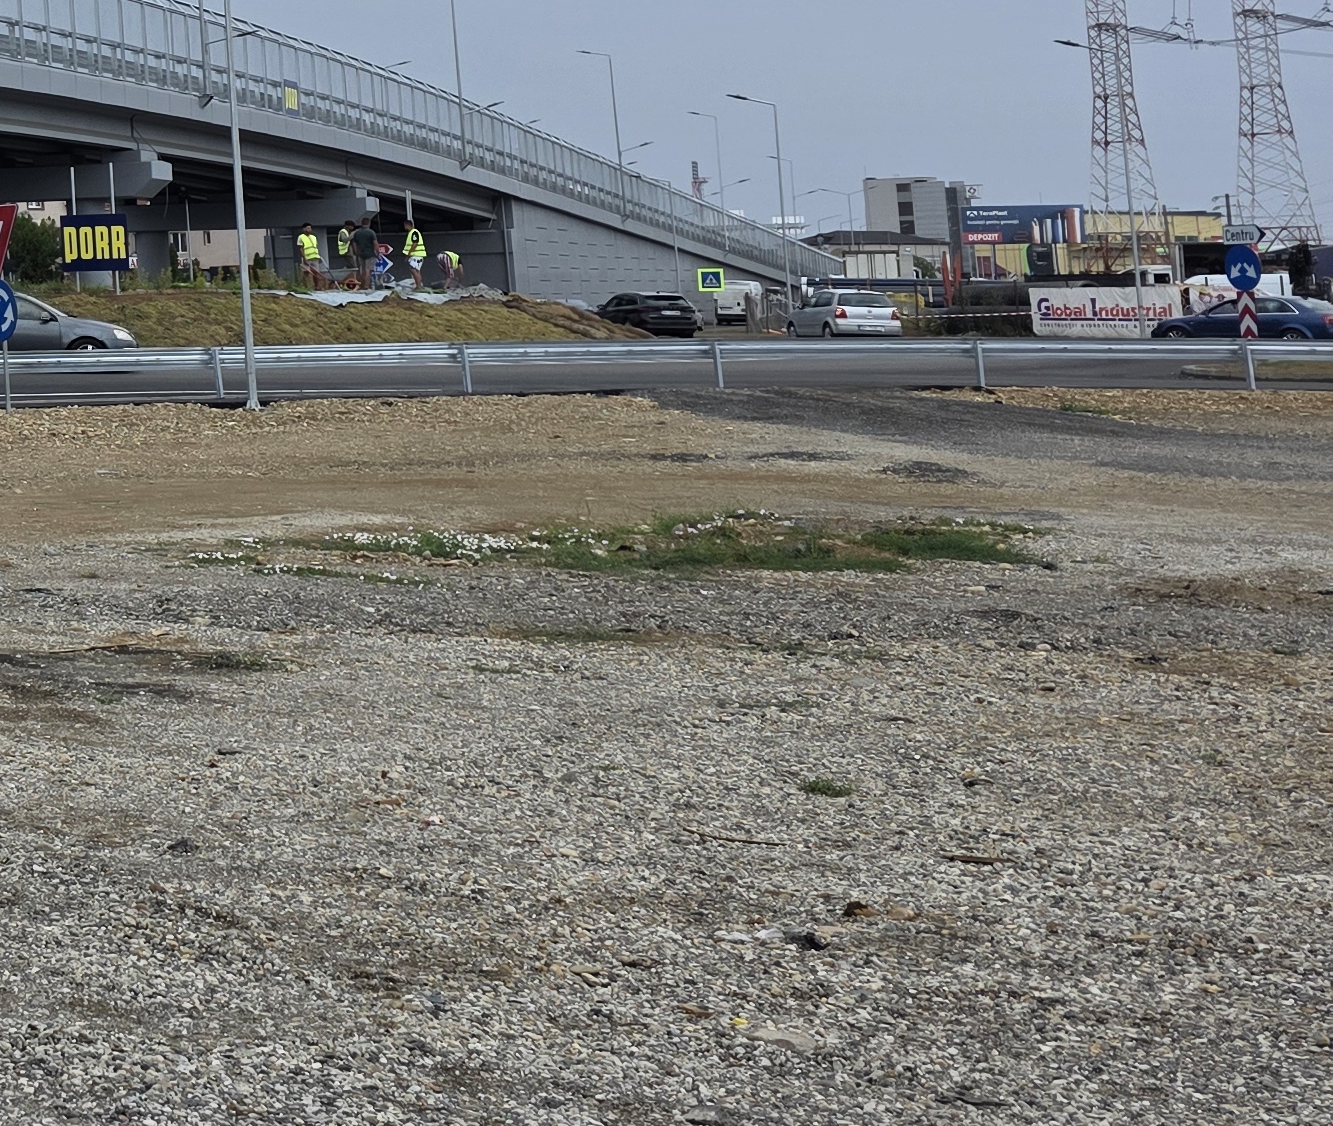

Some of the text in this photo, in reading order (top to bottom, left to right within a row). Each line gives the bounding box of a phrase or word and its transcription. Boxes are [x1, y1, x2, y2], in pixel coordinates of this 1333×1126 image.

[968, 233, 999, 241] DEPOZIT
[1225, 229, 1254, 242] Centru
[63, 226, 127, 264] PORR
[1037, 297, 1087, 317] Global
